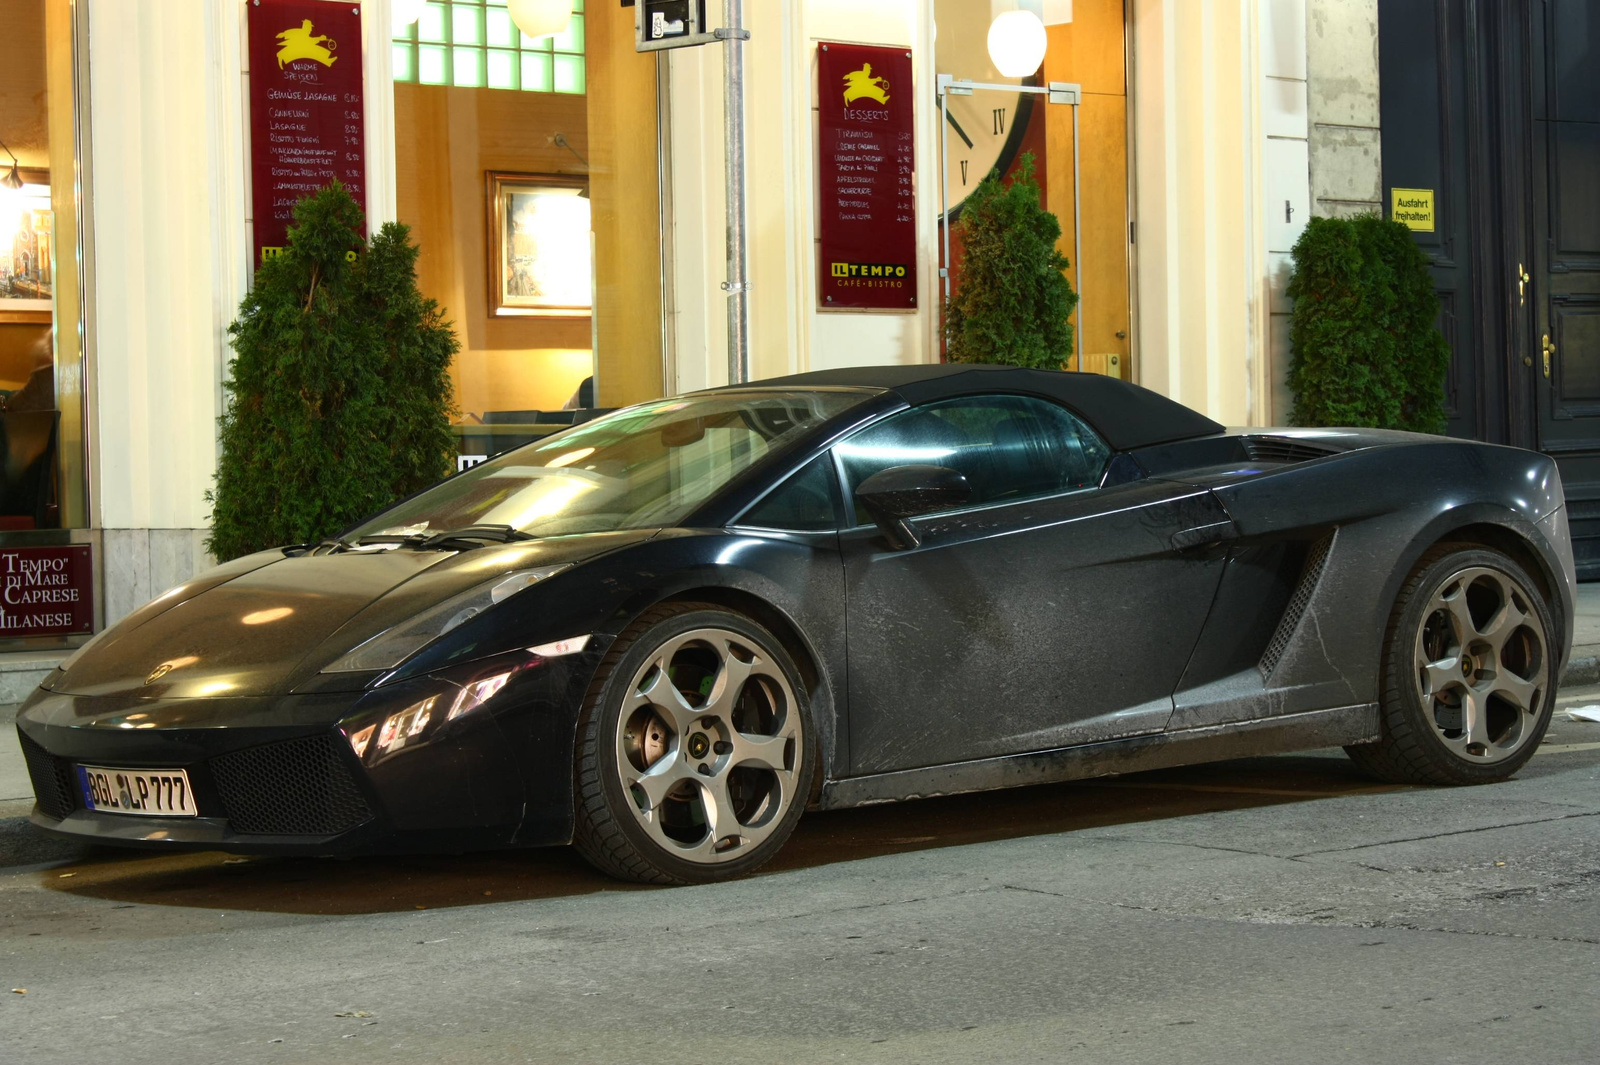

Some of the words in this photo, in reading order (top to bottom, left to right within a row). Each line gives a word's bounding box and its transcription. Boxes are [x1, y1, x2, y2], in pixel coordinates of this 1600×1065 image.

[304, 92, 337, 102] LASAGNE
[844, 108, 888, 120] DESSERTS
[269, 120, 306, 131] LASAGNE
[836, 129, 873, 139] TIRAMISU
[1397, 198, 1428, 208] Ausfahrt
[1395, 211, 1430, 221] freihalten!
[849, 265, 905, 277] TEMPO
[25, 570, 68, 586] MARE
[4, 584, 79, 604] CAPRESE
[88, 772, 119, 807] BGL
